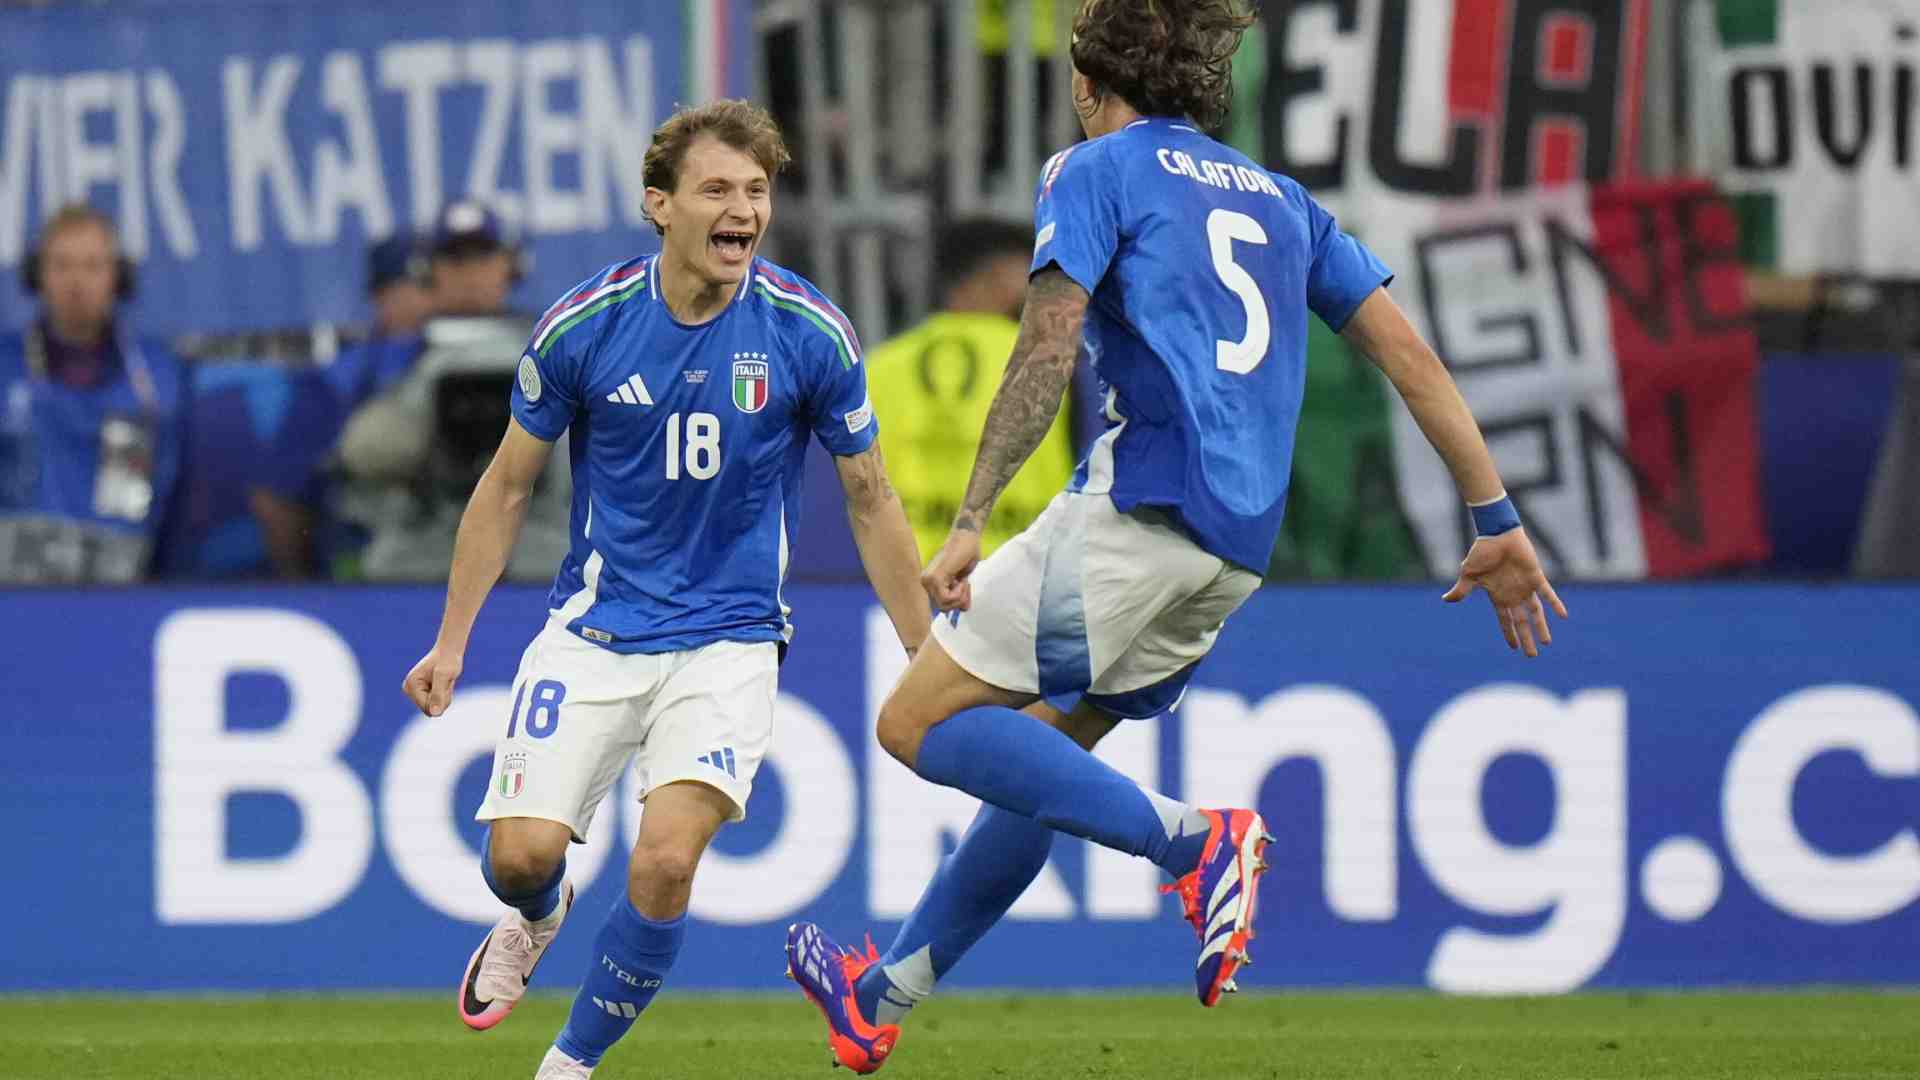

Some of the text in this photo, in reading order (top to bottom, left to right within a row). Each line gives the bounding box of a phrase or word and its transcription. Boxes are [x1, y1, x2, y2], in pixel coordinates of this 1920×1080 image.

[223, 36, 655, 252] KATZEN
[1156, 148, 1284, 199] CALAFIORI
[1207, 208, 1270, 375] 5
[735, 364, 765, 376] ITALIA
[665, 412, 721, 480] 18
[507, 679, 566, 739] 18
[602, 954, 661, 989] ITALIA
